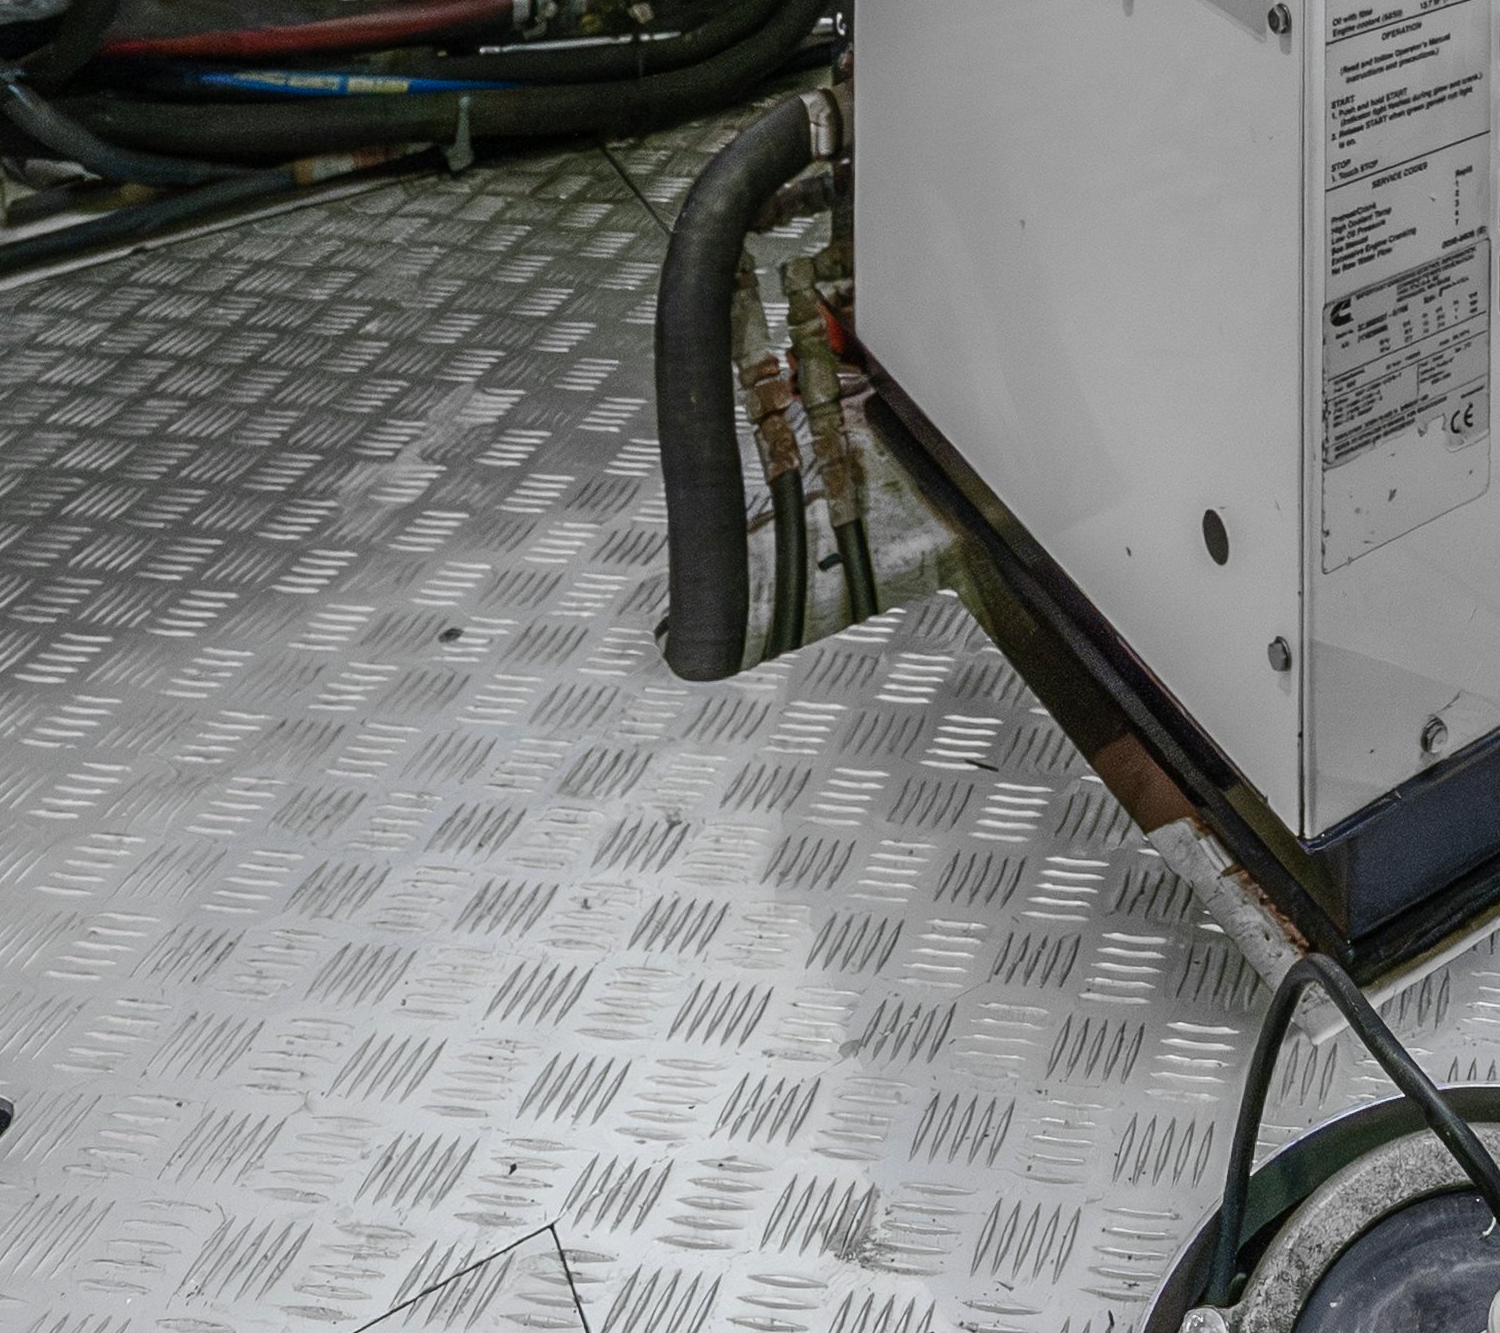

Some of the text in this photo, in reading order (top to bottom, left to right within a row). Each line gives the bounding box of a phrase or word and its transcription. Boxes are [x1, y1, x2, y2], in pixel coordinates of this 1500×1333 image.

[1381, 21, 1421, 41] OPERATION
[1331, 94, 1355, 110] START
[1386, 86, 1407, 102] START
[1365, 114, 1388, 130] START
[1331, 158, 1351, 173] STOP
[1371, 170, 1401, 189] SERVICE
